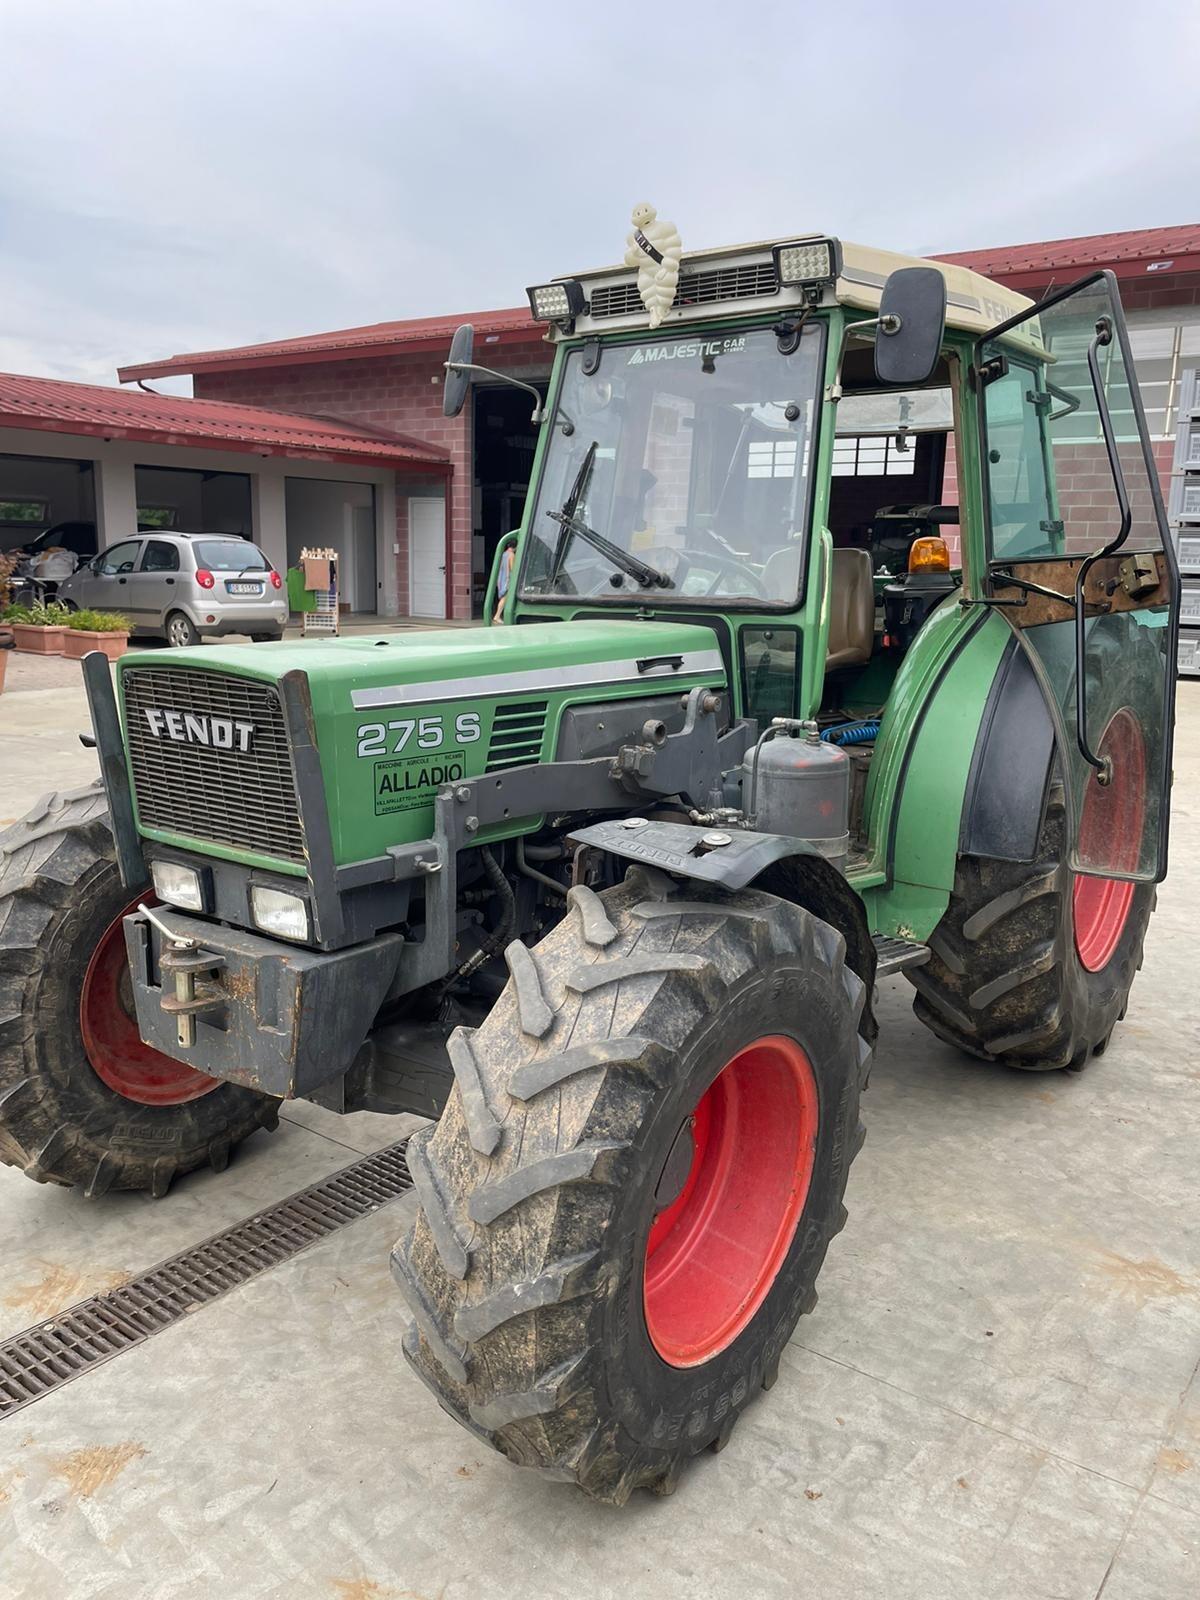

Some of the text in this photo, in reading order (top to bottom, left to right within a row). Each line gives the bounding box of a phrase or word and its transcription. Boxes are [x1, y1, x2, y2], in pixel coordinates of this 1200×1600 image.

[644, 337, 745, 362] MAJESTIC CAR
[145, 709, 256, 752] FENDT
[357, 712, 481, 758] 275 S
[379, 763, 462, 795] ALLADIO
